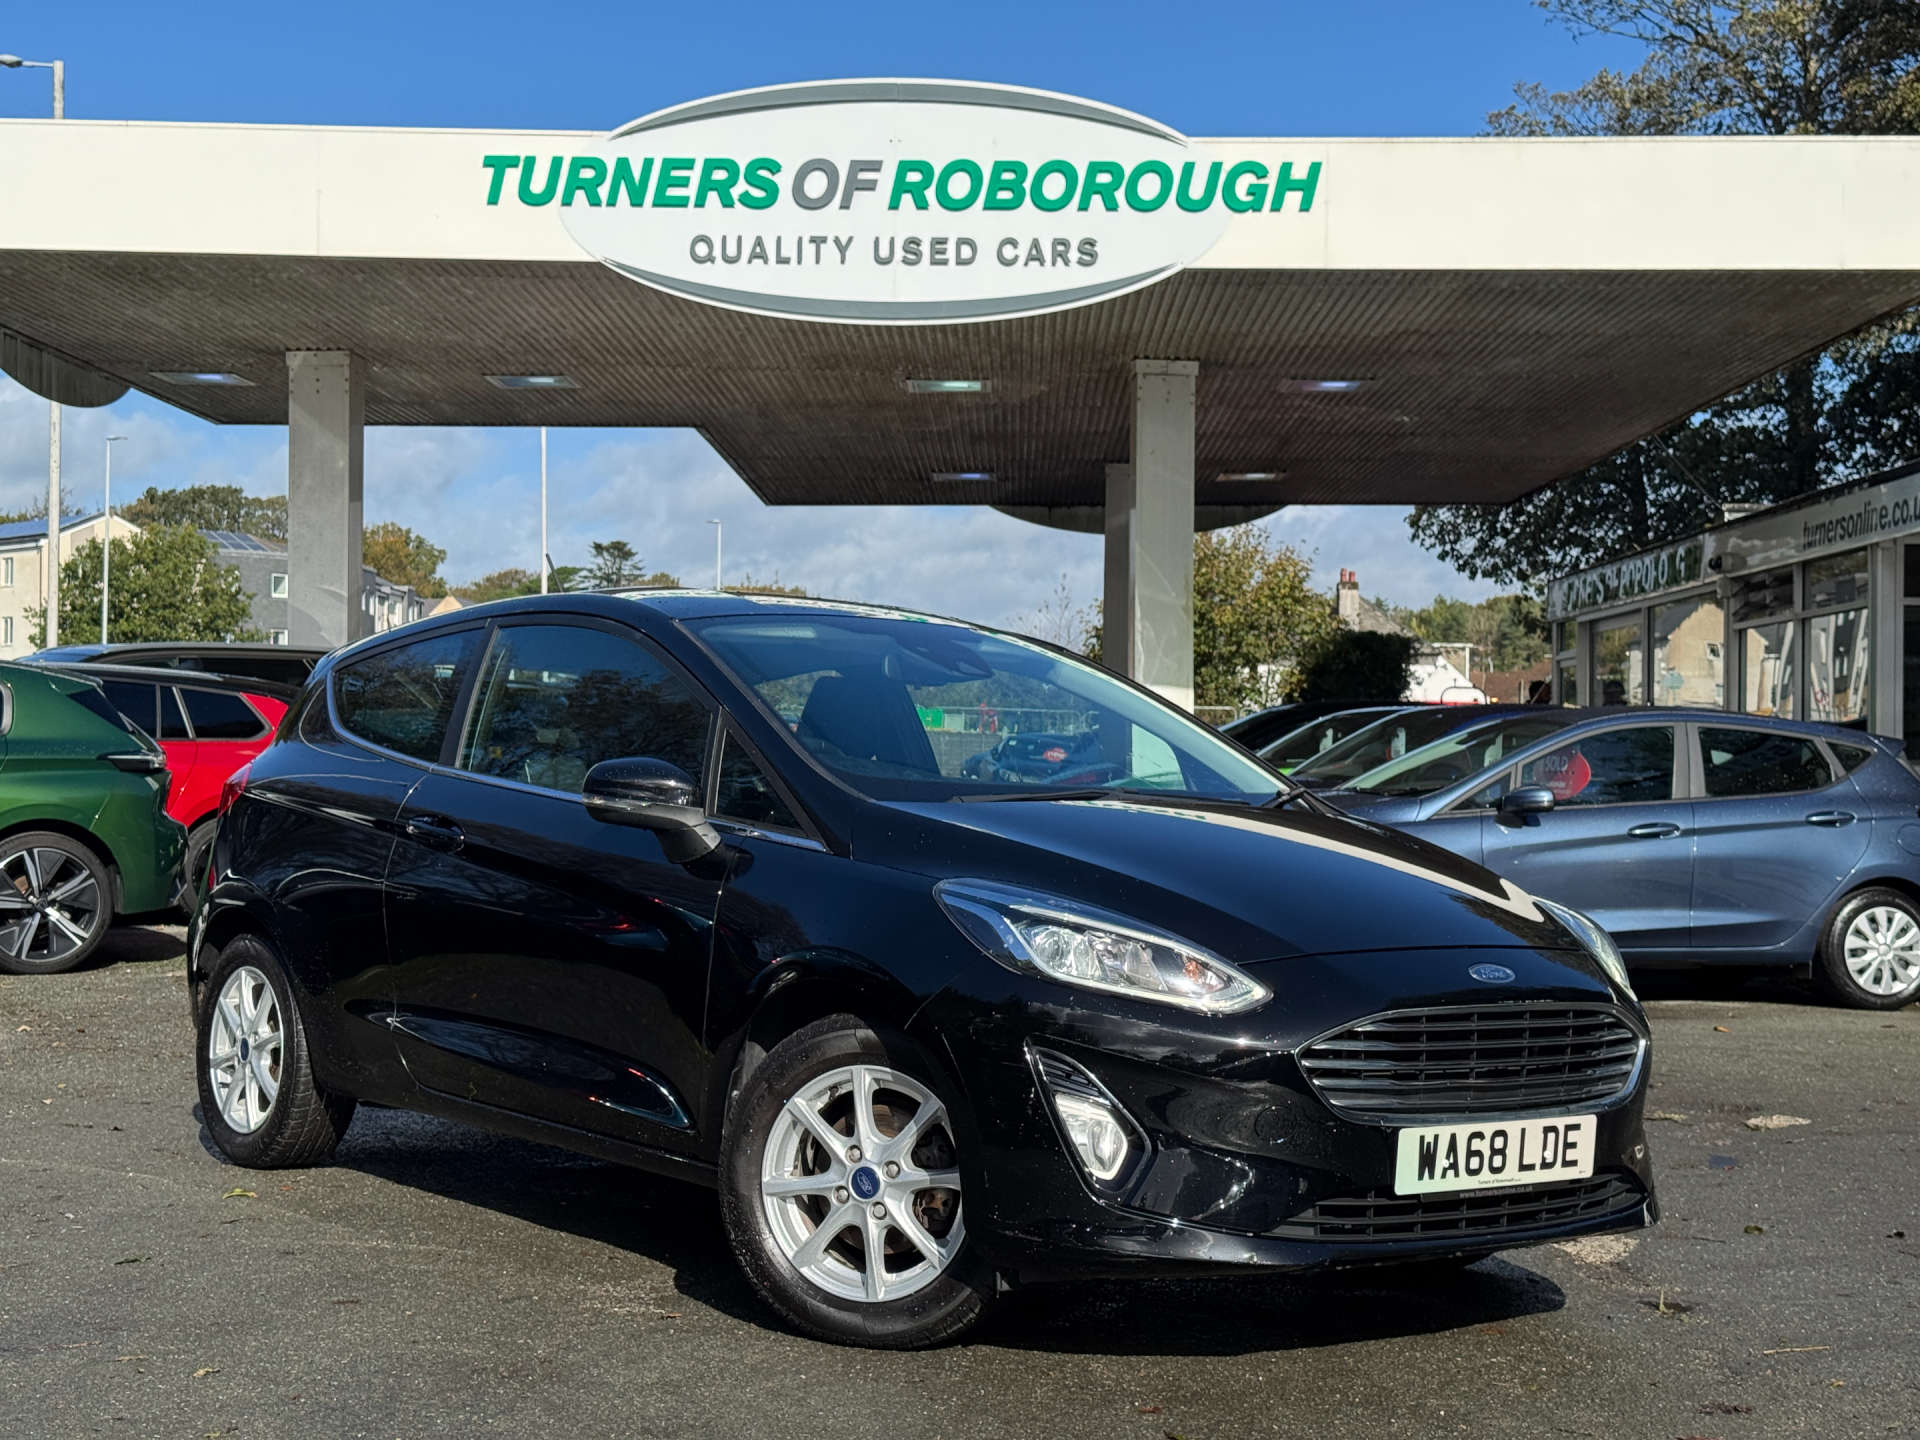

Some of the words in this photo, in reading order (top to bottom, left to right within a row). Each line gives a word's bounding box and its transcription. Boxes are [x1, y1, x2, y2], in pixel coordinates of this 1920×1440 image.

[482, 155, 782, 210] TURNERS
[792, 158, 883, 211] OF
[888, 158, 1322, 213] ROBOROUGH
[689, 235, 854, 265] QUALITY
[873, 237, 978, 266] USED
[996, 237, 1099, 267] CARS
[1417, 1129, 1509, 1181] WA68
[1518, 1123, 1581, 1172] LDE
